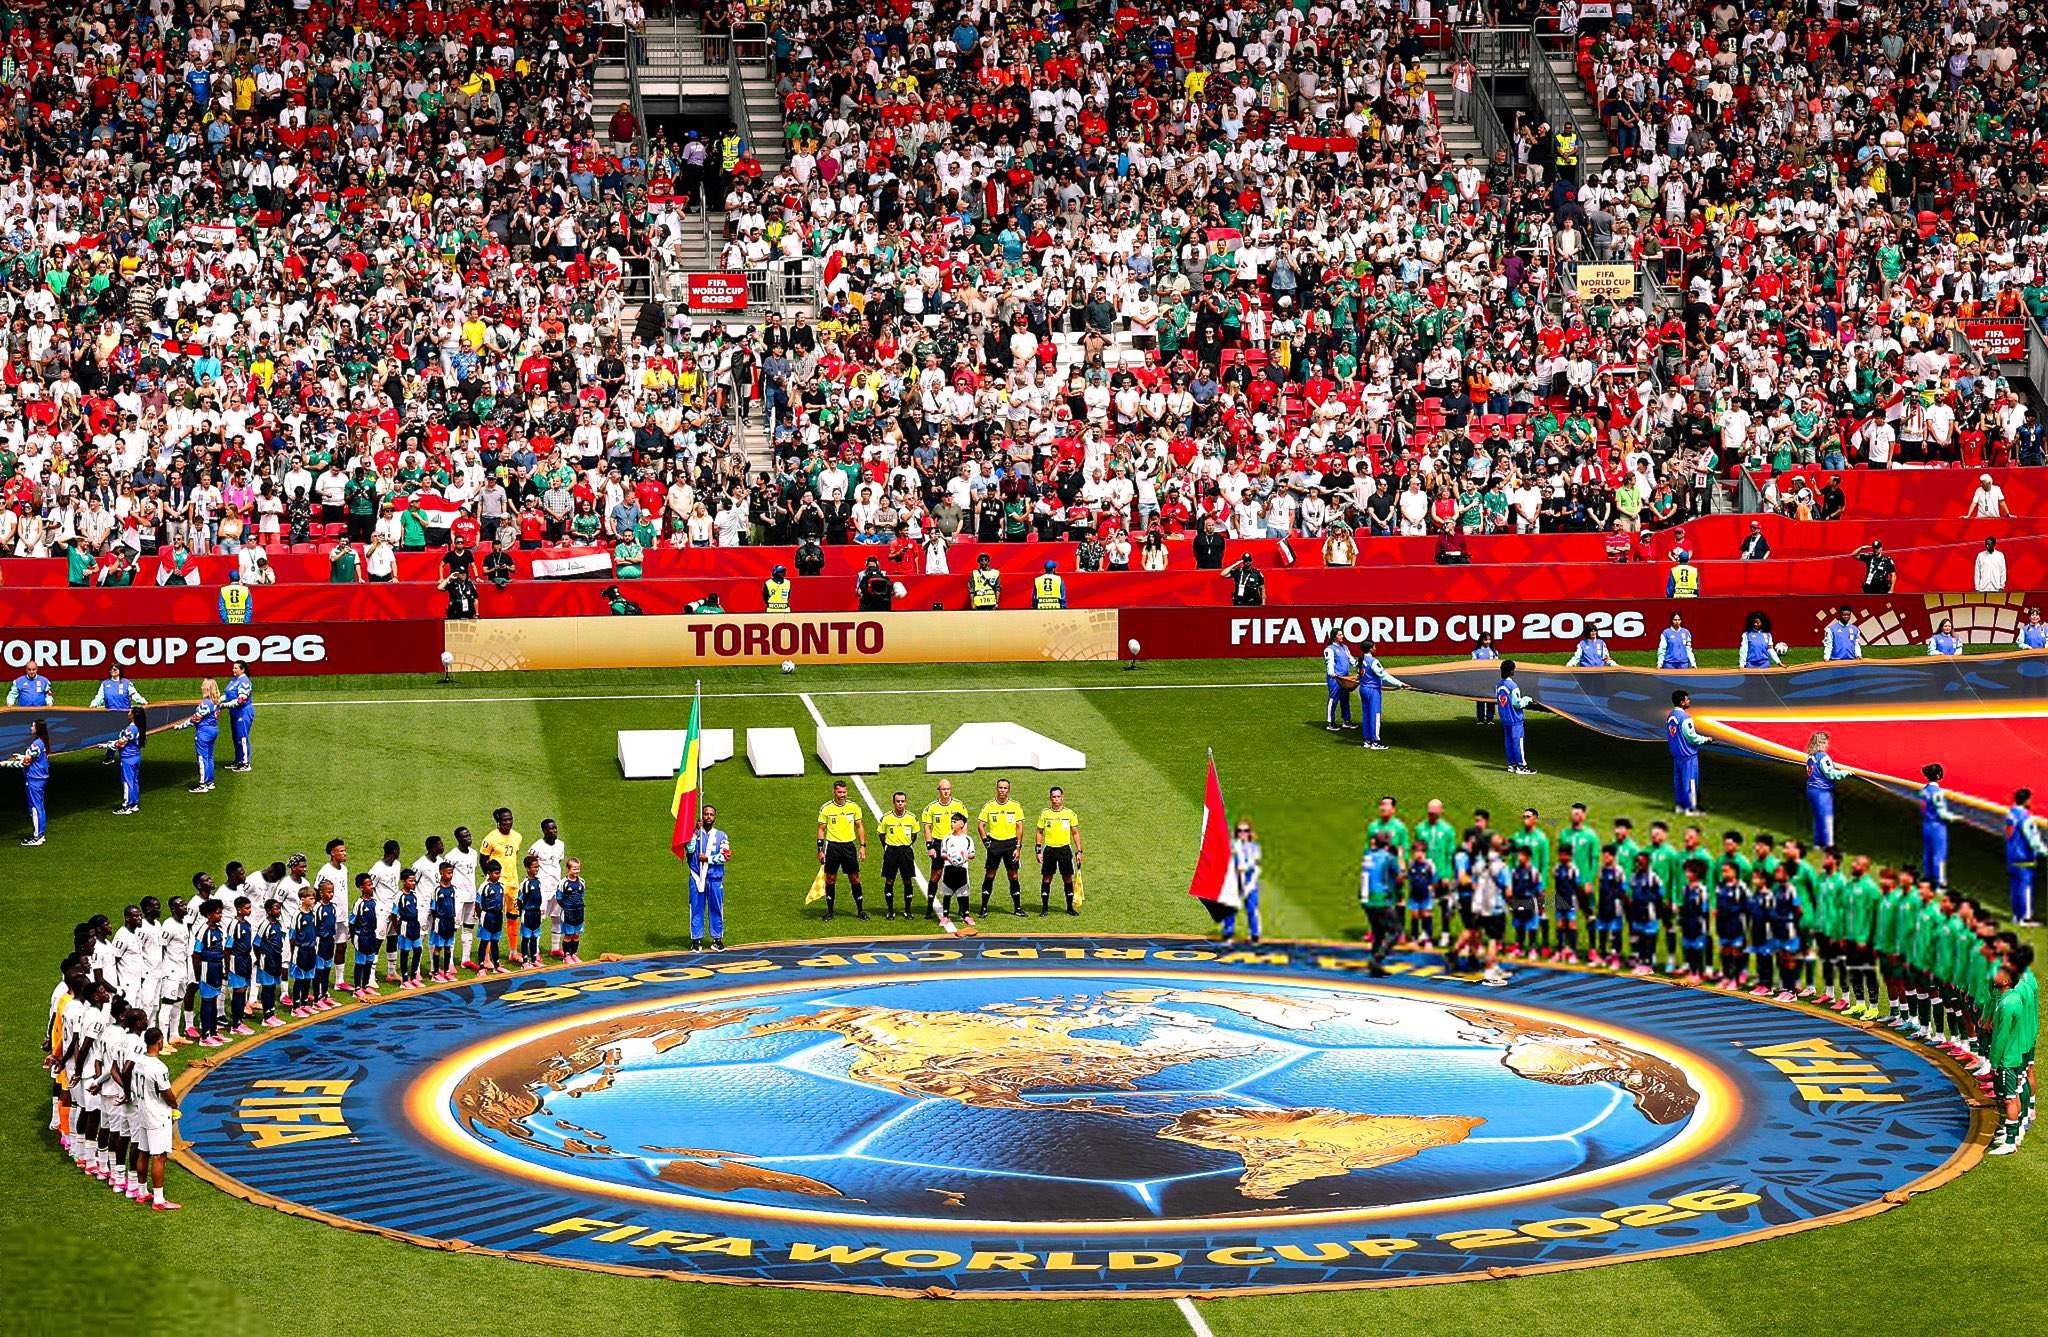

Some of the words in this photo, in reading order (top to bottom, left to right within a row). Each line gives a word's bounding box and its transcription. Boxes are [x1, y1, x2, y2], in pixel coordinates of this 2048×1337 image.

[692, 287, 725, 295] WORLD
[701, 295, 734, 303] 2026
[1985, 330, 2005, 338] FIFA
[2003, 338, 2021, 346] CUP
[688, 621, 884, 656] TORONTO
[1231, 617, 1305, 645] FIFA
[1310, 615, 1439, 643] WORLD
[1445, 614, 1516, 641] CUP
[1522, 611, 1644, 640] 2026
[0, 638, 107, 667] ORLD
[113, 637, 188, 666] CUP
[195, 635, 325, 664] 2026
[797, 950, 963, 967] CUP
[982, 947, 1290, 964] WORLD
[499, 959, 783, 1003] 2026
[1746, 1037, 1904, 1103] FIFA
[239, 1080, 354, 1149] FIFA
[533, 1217, 753, 1257] FIFA
[788, 1242, 1182, 1270] WORLD
[1206, 1238, 1419, 1266] CUP
[1436, 1188, 1762, 1250] 2026
